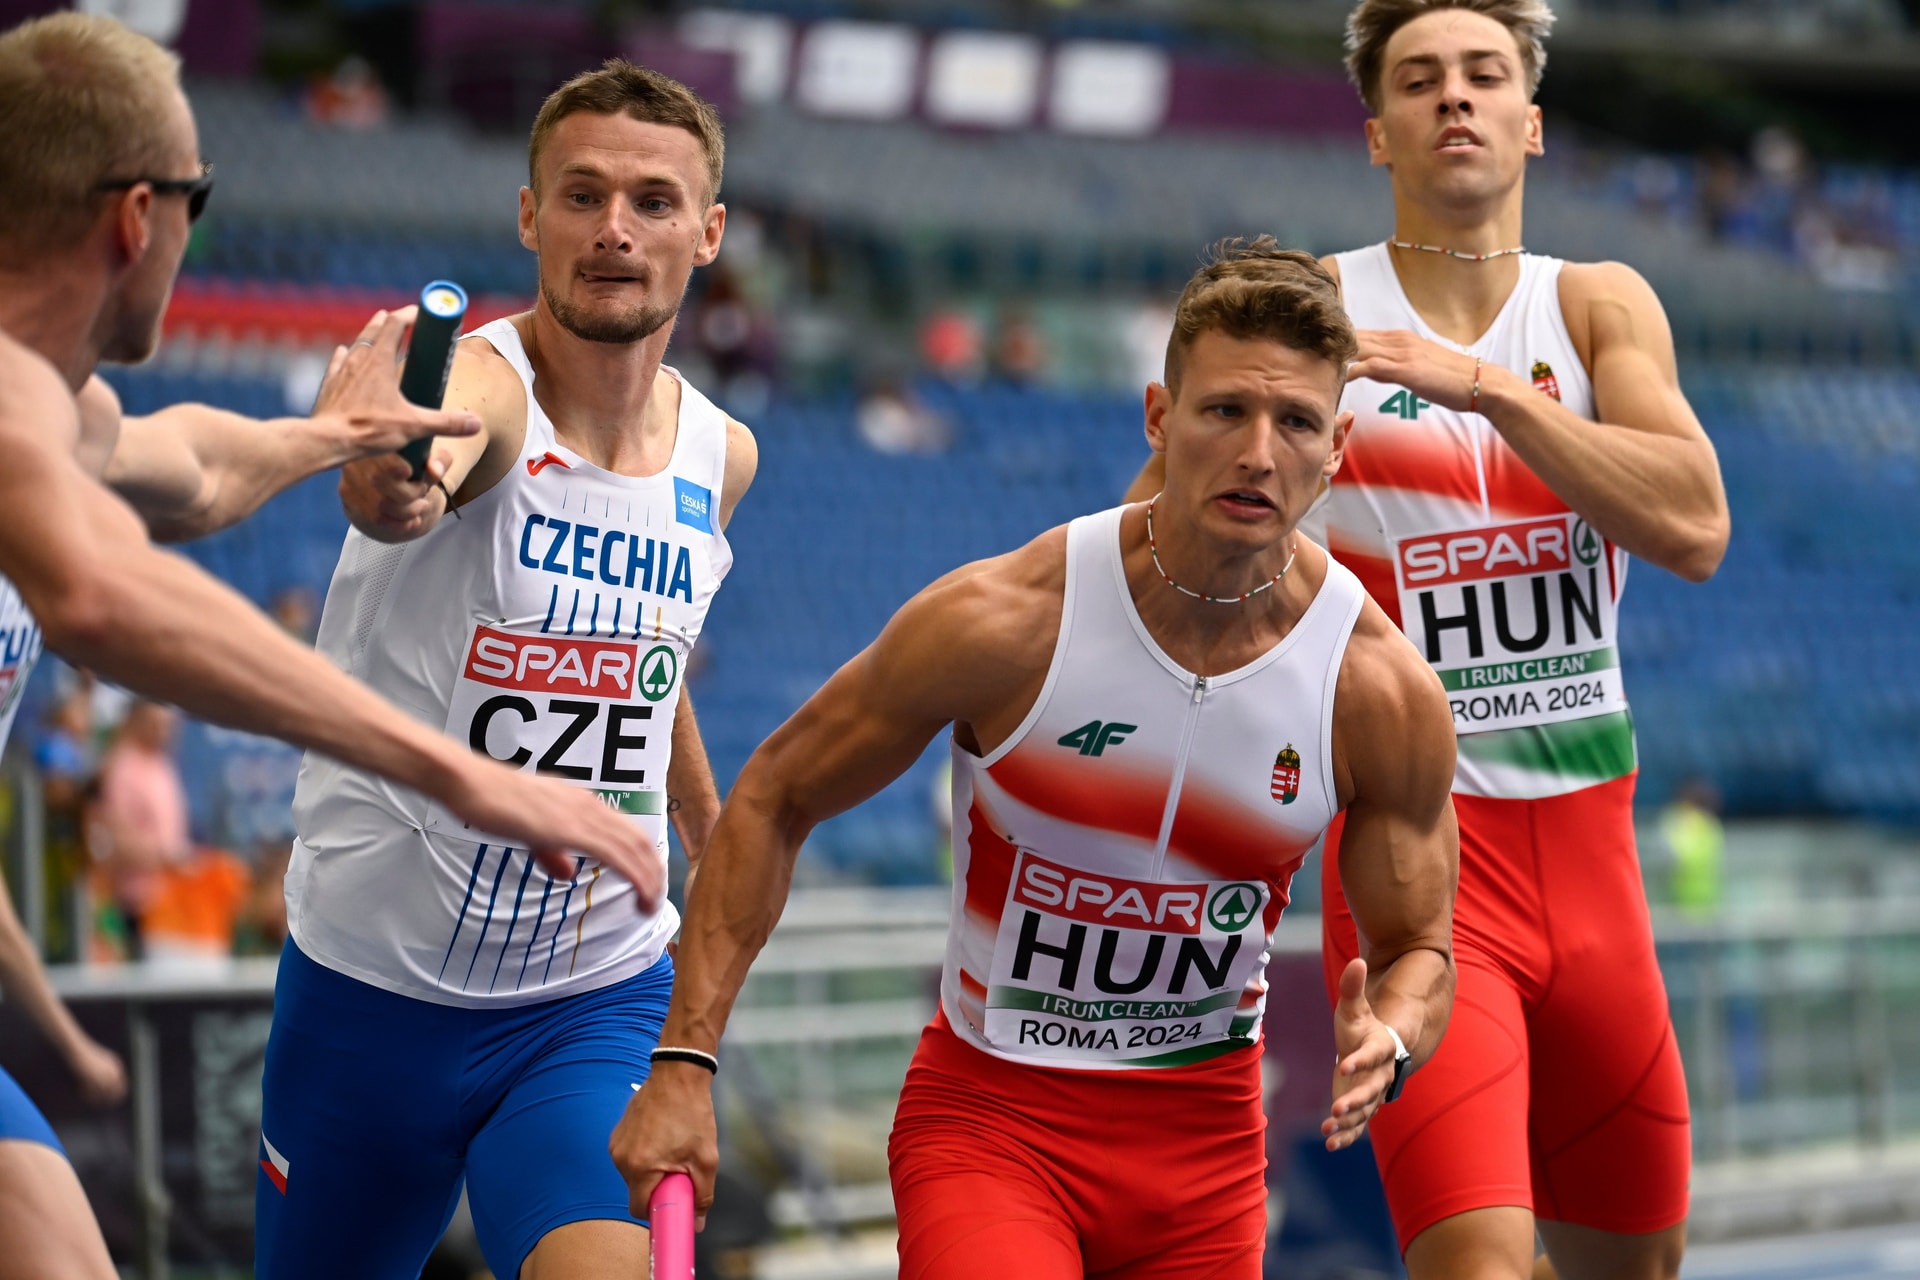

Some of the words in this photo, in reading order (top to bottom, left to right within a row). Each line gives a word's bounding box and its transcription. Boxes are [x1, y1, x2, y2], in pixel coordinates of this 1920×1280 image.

[519, 513, 692, 604] CZECHIA
[1404, 526, 1567, 581] SPAR
[1419, 567, 1602, 663] HUN
[472, 636, 631, 690] SPAR
[1460, 671, 1467, 687] I
[1471, 664, 1519, 686] RUN
[1450, 691, 1540, 723] ROMA
[1547, 681, 1605, 712] 2024
[469, 695, 653, 784] CZE
[1057, 720, 1138, 757] 4F
[1021, 863, 1200, 927] SPAR
[1011, 910, 1242, 995] HUN
[1042, 995, 1049, 1010] I
[1054, 999, 1104, 1018] RUN
[1018, 1019, 1119, 1050] ROMA
[1127, 1022, 1202, 1048] 2024
